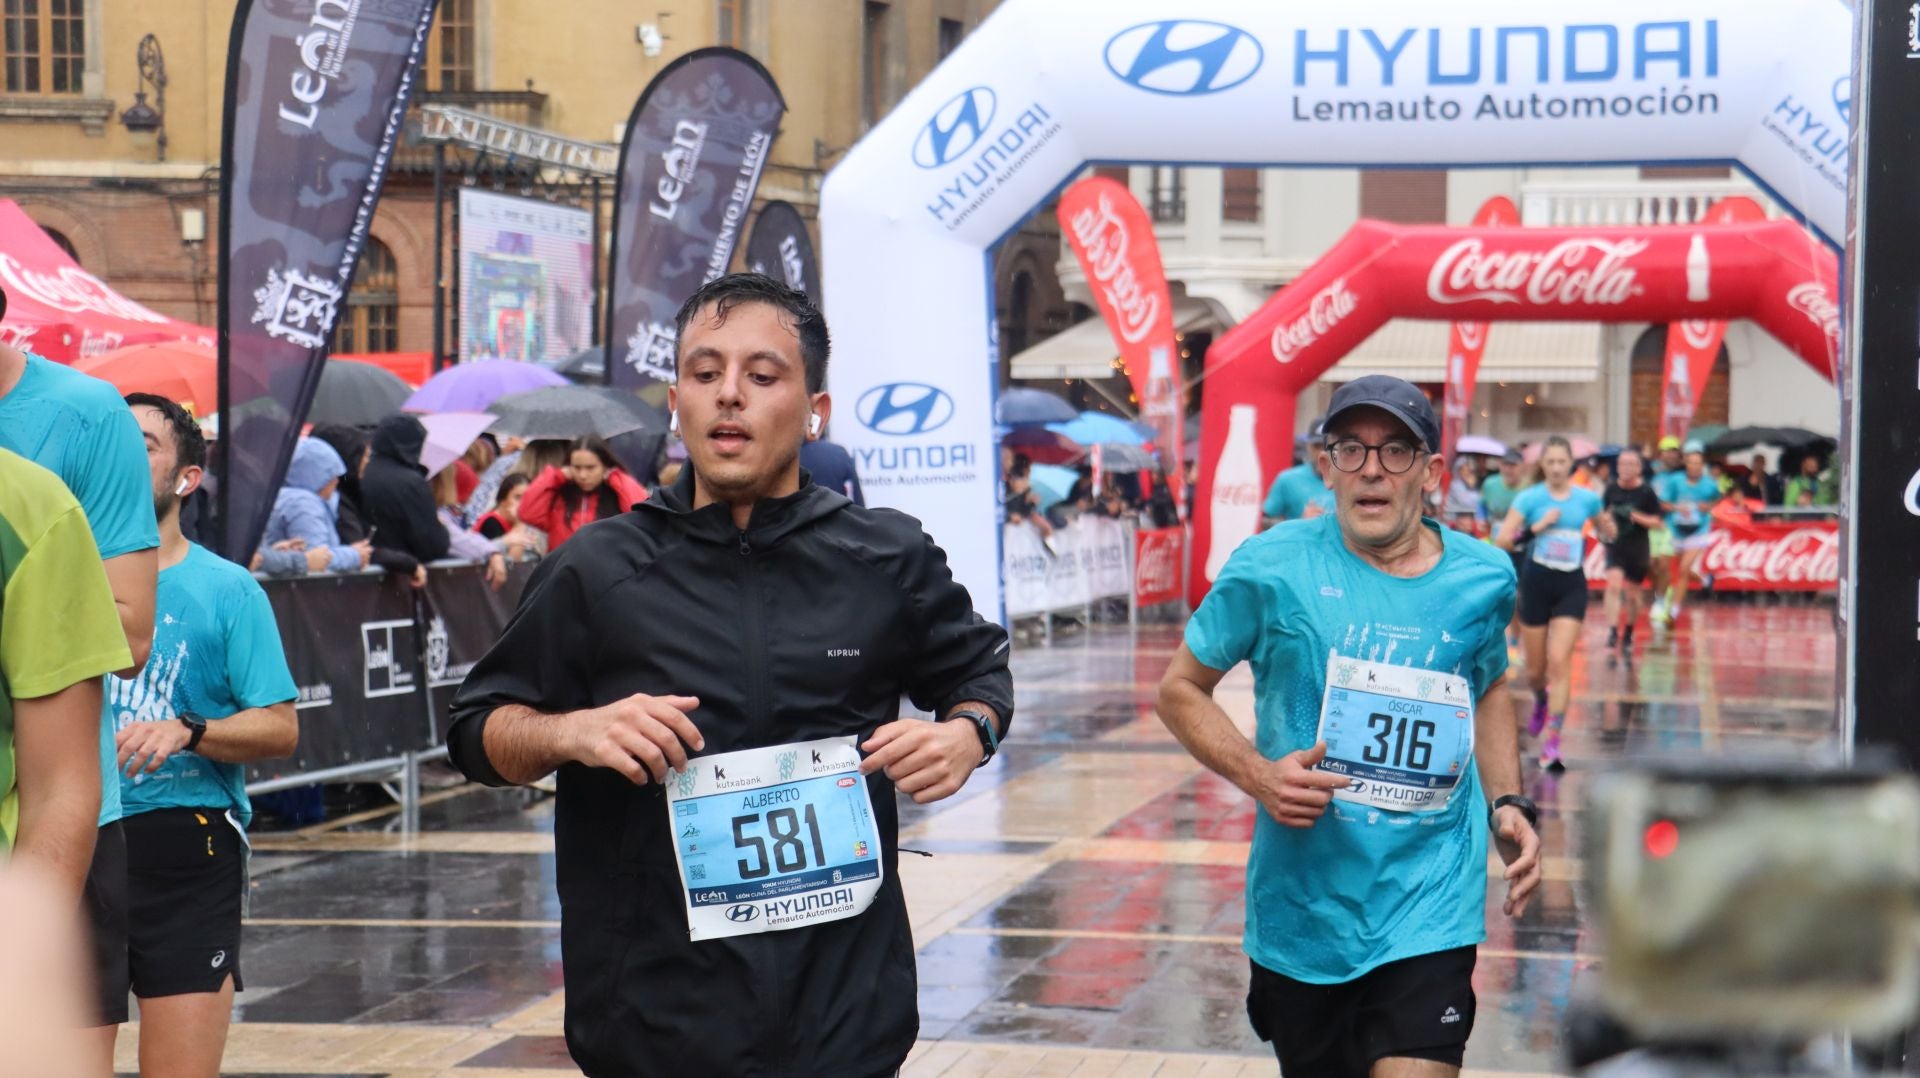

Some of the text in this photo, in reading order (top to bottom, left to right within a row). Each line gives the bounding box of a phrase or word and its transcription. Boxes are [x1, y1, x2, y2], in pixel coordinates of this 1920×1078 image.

[1294, 20, 1719, 86] HYUNDAI
[1293, 86, 1719, 122] Lemauto Automoción
[739, 130, 766, 177] LEÓN
[927, 102, 1051, 220] HYUNDAI
[945, 121, 1063, 231] Lemauto Automoción
[1072, 192, 1159, 344] Coca-Cola
[1427, 228, 1650, 304] Coca-Cola
[1271, 277, 1359, 364] Coca-Cola
[827, 648, 861, 658] KIPRUN
[1388, 700, 1423, 715] ÓSCAR
[1362, 712, 1436, 771] 316
[716, 775, 762, 789] kutxabank
[812, 759, 856, 773] kutxabank
[742, 787, 800, 810] ALBERTO
[1371, 784, 1435, 801] HYUNDAI
[732, 803, 825, 880] 581
[765, 888, 853, 917] HYUNDAI
[767, 904, 854, 925] Lemauto Automoción
